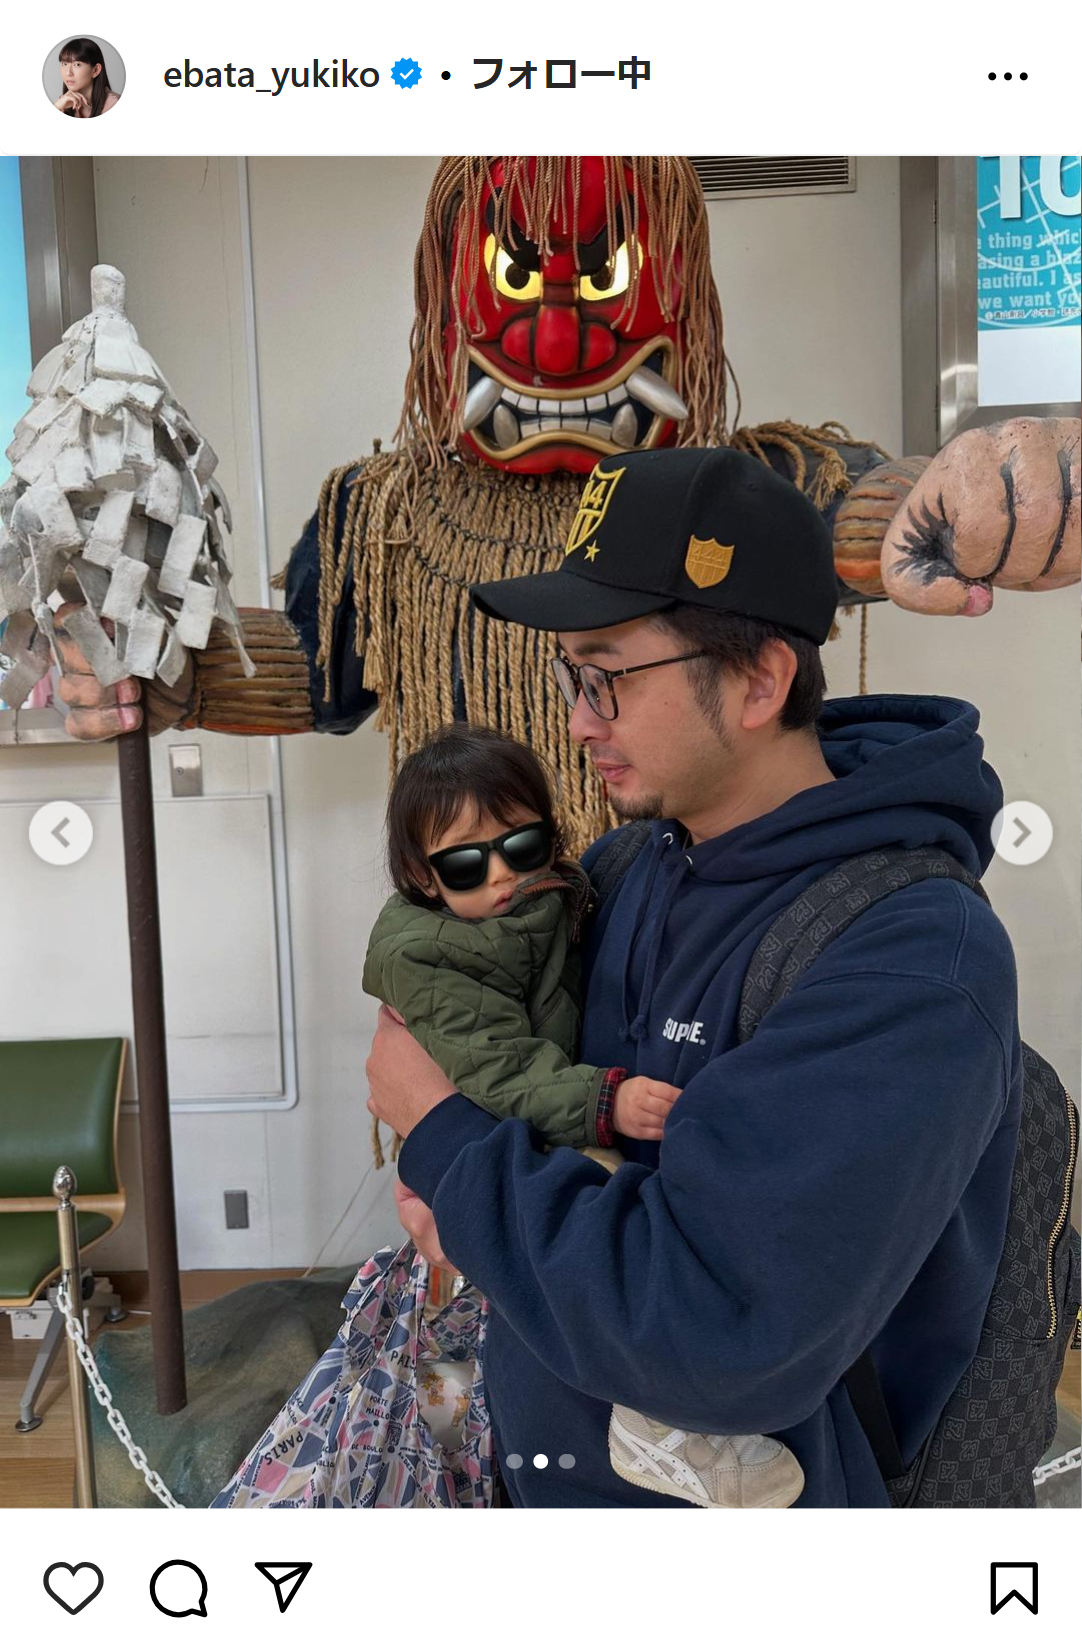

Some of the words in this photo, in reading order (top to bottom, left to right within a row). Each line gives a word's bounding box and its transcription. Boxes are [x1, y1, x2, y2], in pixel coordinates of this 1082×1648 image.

[988, 232, 1032, 250] thing
[1030, 254, 1040, 267] a
[977, 296, 1002, 310] we
[1009, 291, 1052, 308] want
[264, 1431, 304, 1465] PARIS
